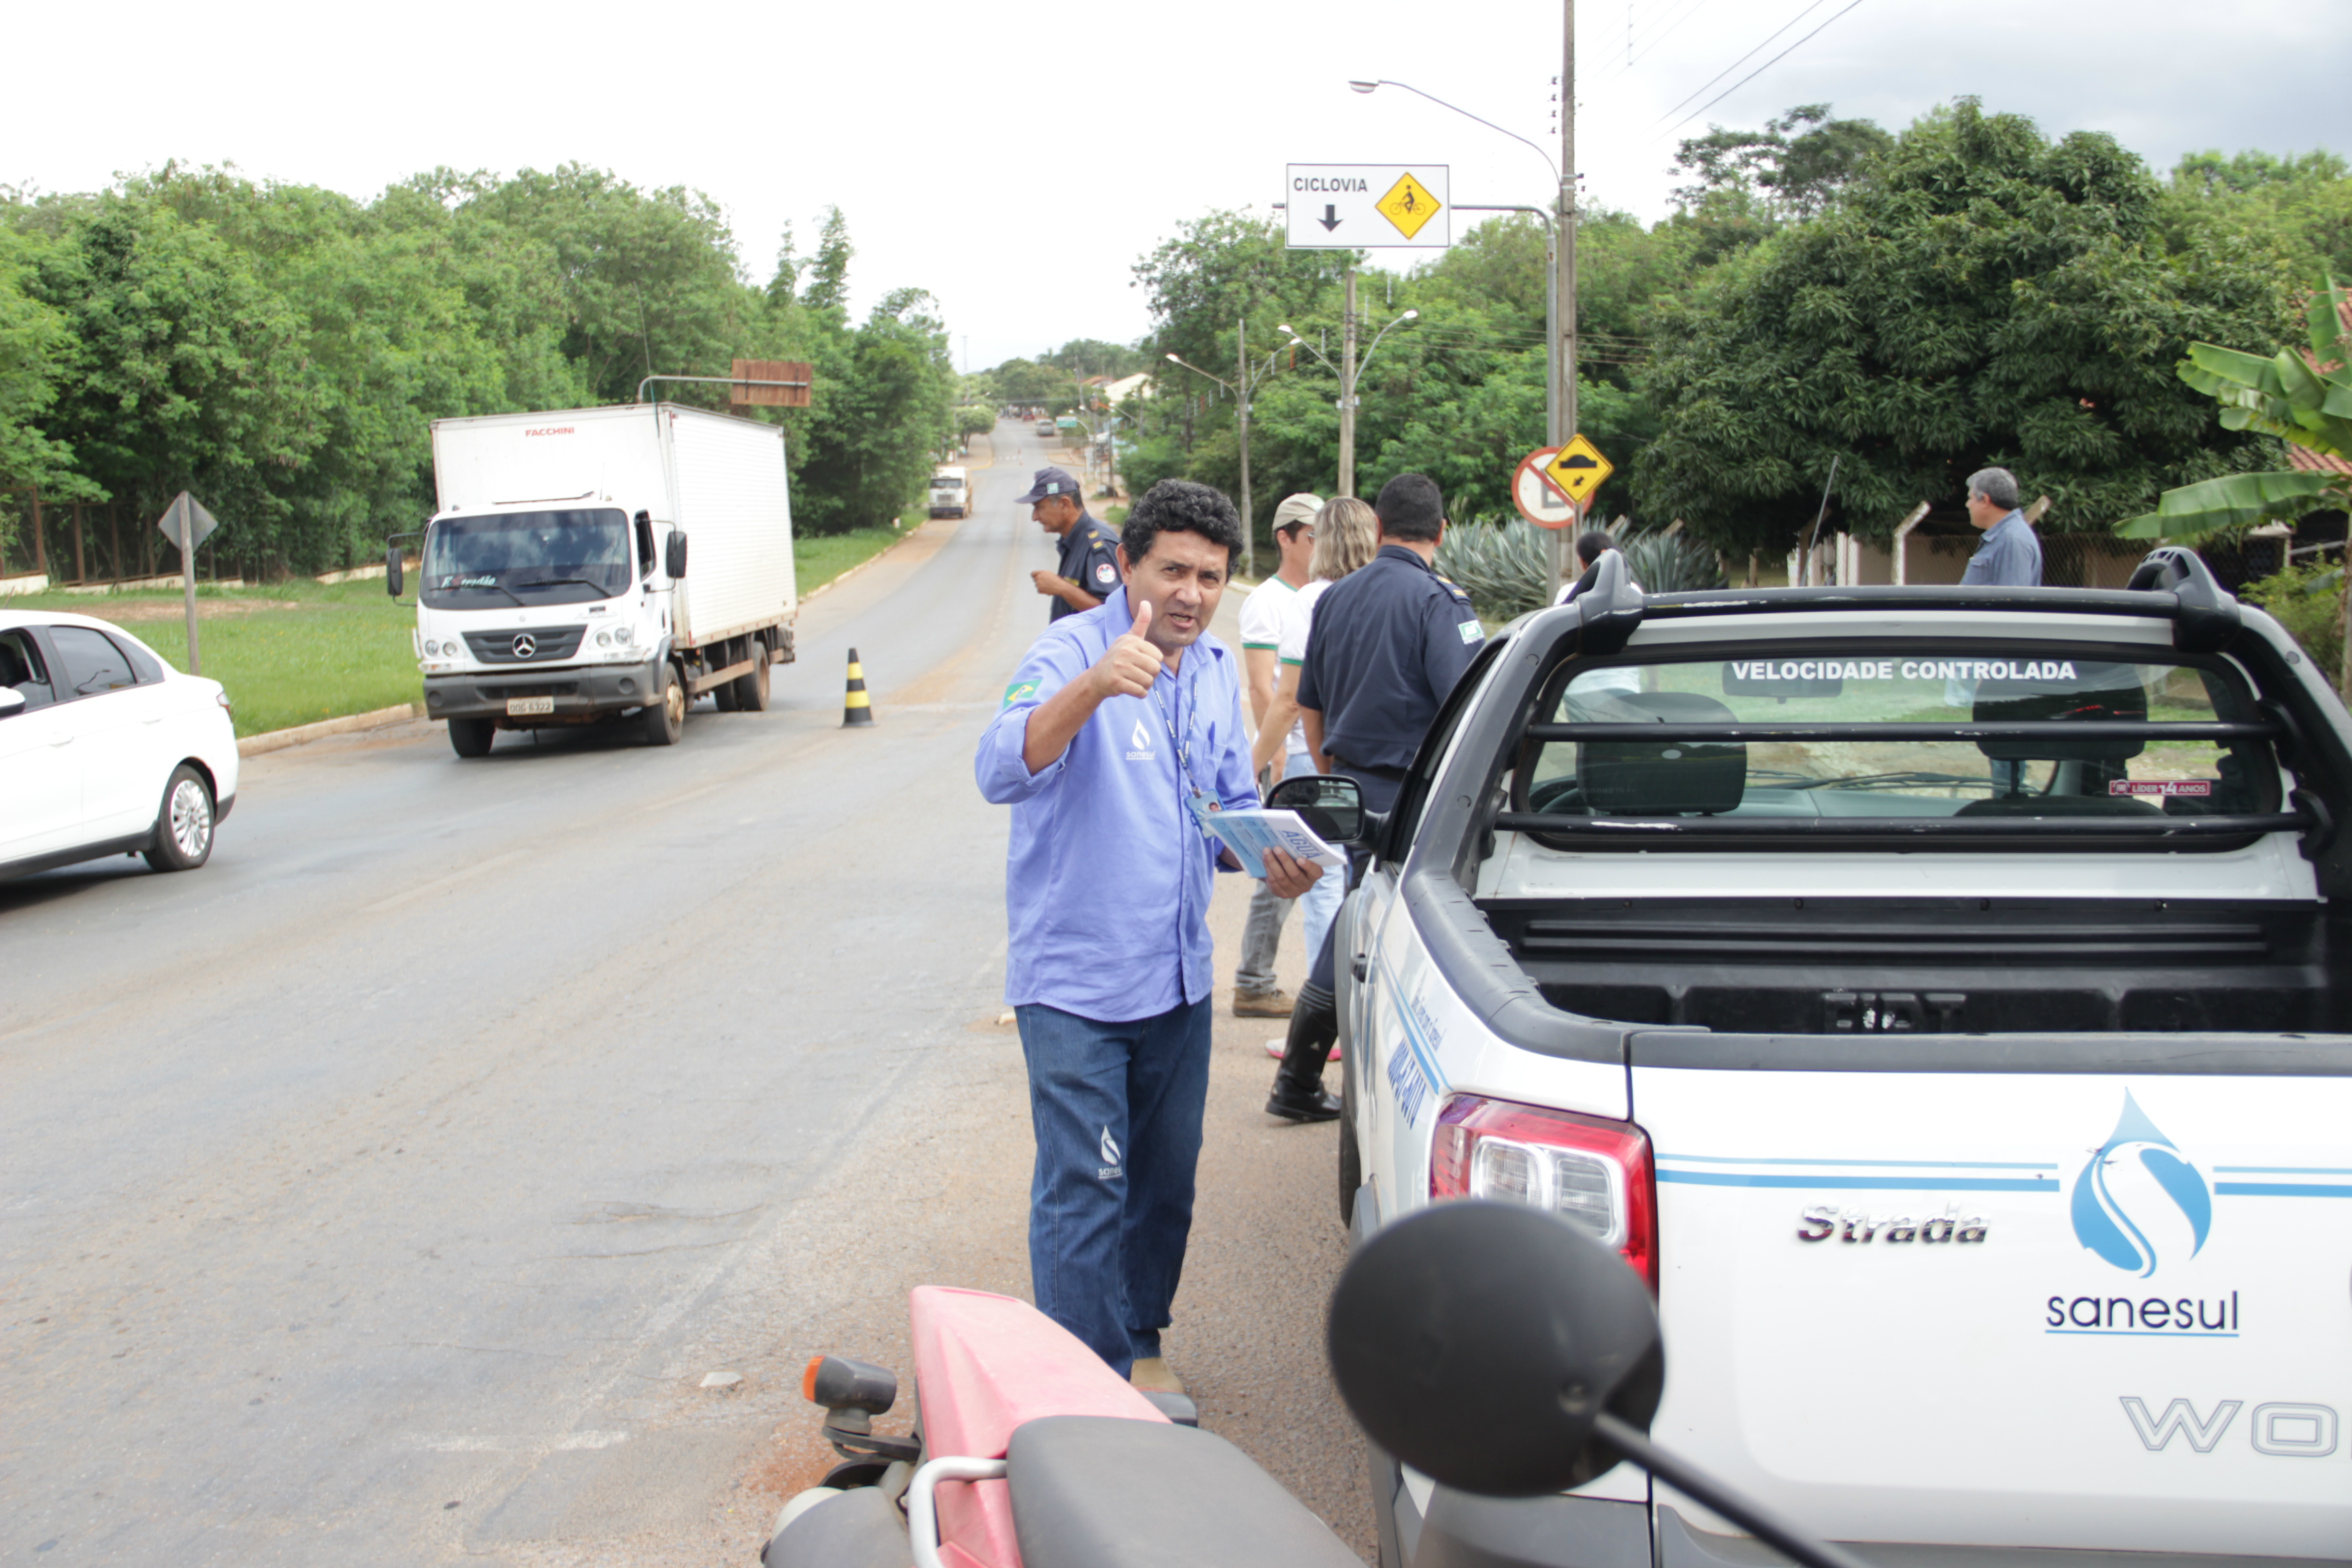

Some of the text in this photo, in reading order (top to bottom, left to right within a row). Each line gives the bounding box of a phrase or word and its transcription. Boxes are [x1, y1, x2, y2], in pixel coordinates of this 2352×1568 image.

[1294, 178, 1367, 192] CICLOVIA
[525, 427, 574, 436] FACCHINI
[1731, 662, 2076, 680] VELOCIDADE CONTROLADA
[2159, 781, 2177, 794] 14
[2178, 785, 2206, 793] ANOS
[1098, 1166, 1122, 1176] sanes
[1798, 1200, 1989, 1244] Strada
[2046, 1291, 2238, 1330] sanesul
[2119, 1396, 2352, 1457] WO
